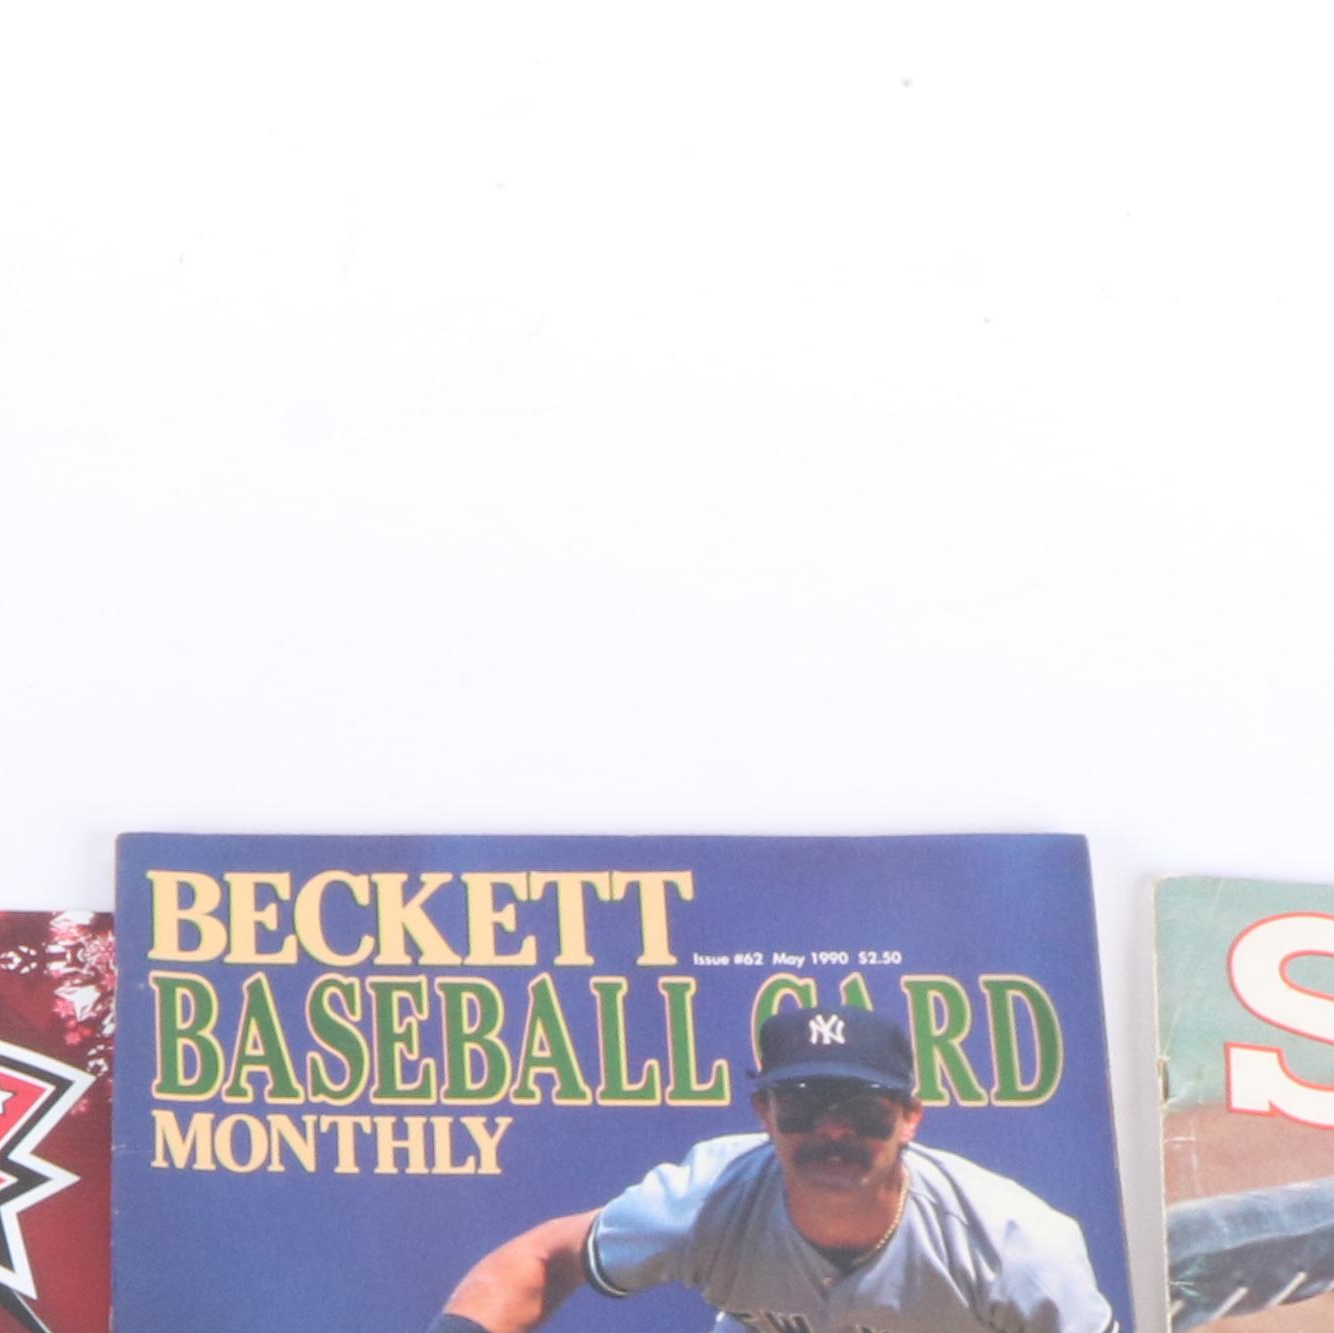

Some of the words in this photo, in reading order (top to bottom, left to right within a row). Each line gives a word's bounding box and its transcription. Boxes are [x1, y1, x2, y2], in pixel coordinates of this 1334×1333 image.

[146, 869, 693, 969] BECKETT
[693, 952, 730, 966] Issue
[733, 952, 764, 966] #62
[772, 952, 806, 968] May
[811, 951, 849, 966] 1990
[858, 951, 902, 966] $2.50
[148, 970, 730, 1107] BASEBALL
[150, 1108, 514, 1176] MONTHLY
